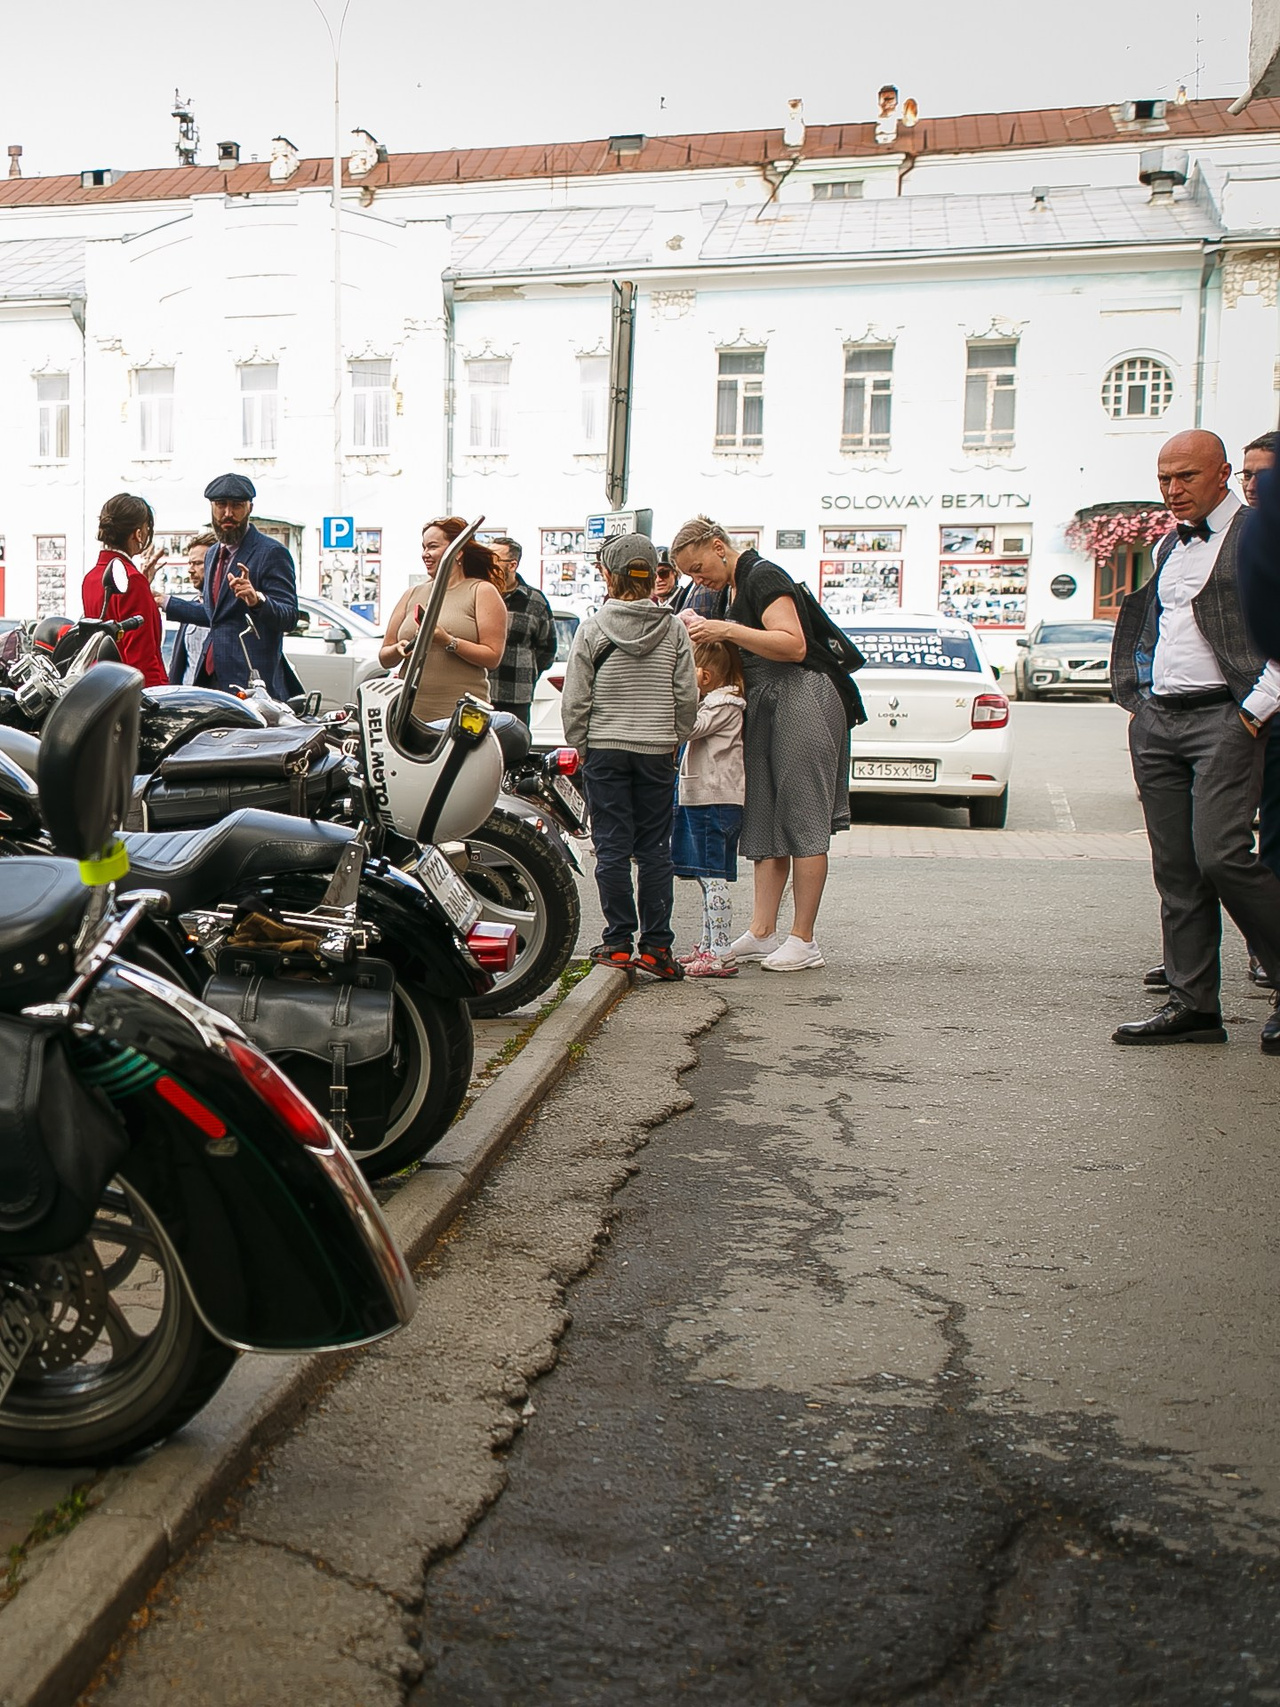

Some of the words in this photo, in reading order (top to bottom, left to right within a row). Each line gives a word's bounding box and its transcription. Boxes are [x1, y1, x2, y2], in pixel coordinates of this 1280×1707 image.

[821, 494, 934, 510] SOLOWAY
[941, 492, 1032, 508] BEAUTY
[330, 518, 350, 547] P
[846, 634, 942, 646] резвый
[860, 643, 942, 654] арщик
[367, 706, 383, 748] BELL
[371, 751, 390, 807] MOTO
[912, 764, 932, 775] 196
[0, 1312, 28, 1360] 66
